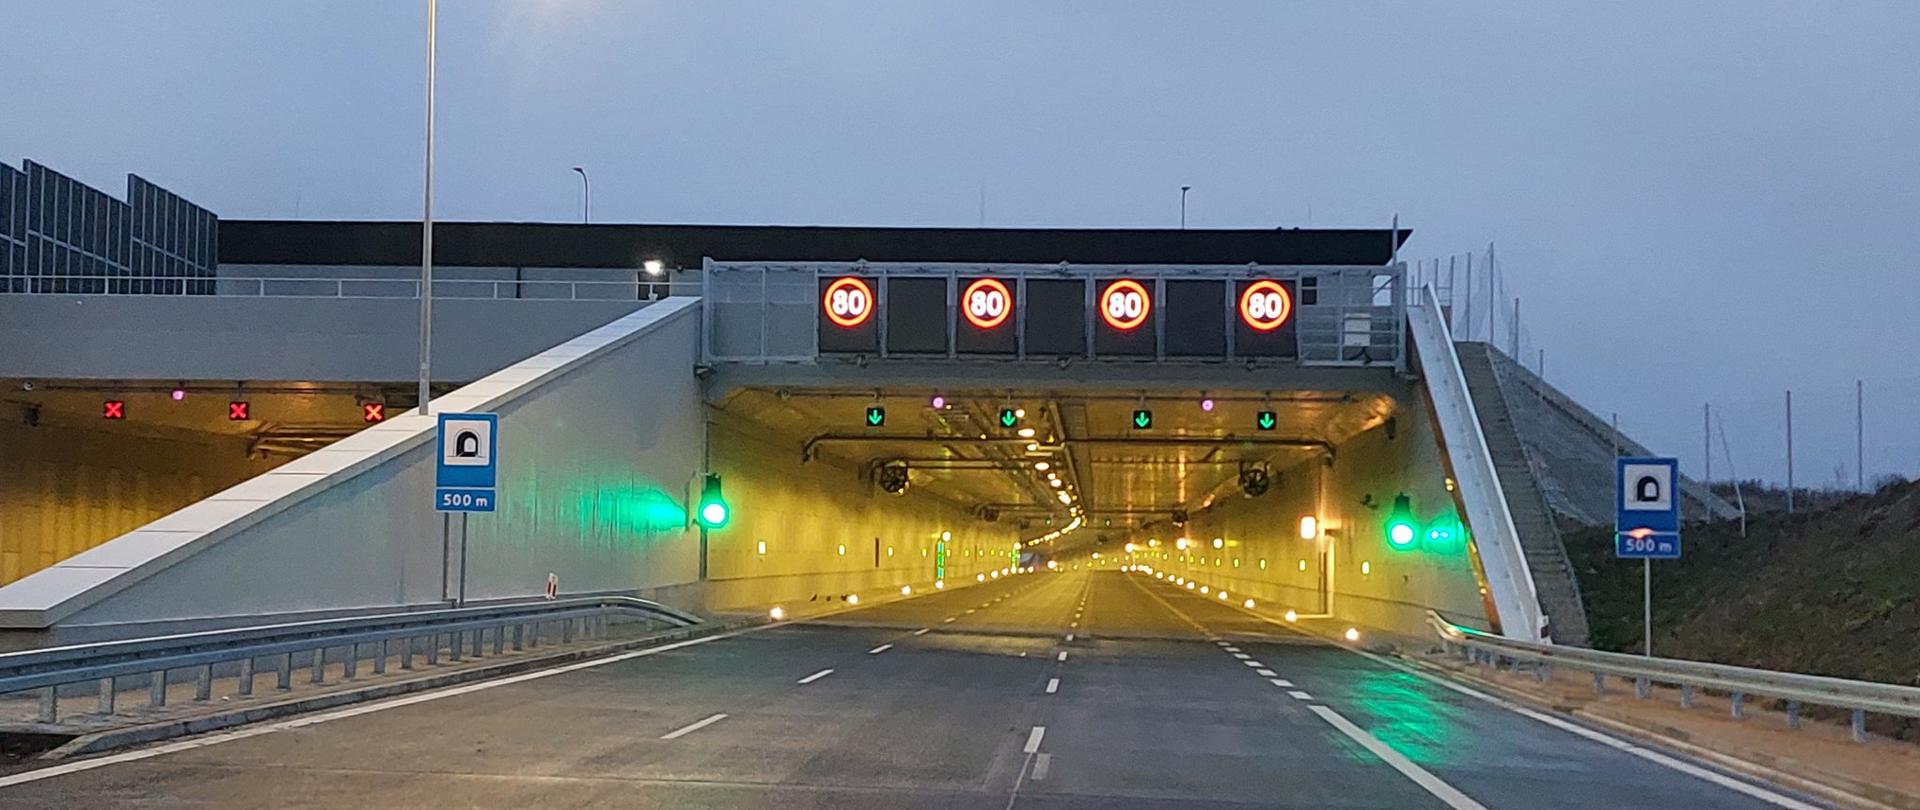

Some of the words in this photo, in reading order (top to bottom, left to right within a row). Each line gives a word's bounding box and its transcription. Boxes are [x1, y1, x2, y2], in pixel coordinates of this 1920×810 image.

[832, 289, 865, 315] 80
[970, 290, 1003, 316] 80
[1109, 292, 1142, 318] 80
[1248, 292, 1282, 319] 80
[443, 494, 472, 506] 500
[475, 497, 488, 507] m
[1625, 538, 1655, 552] 500
[1659, 542, 1672, 553] m
